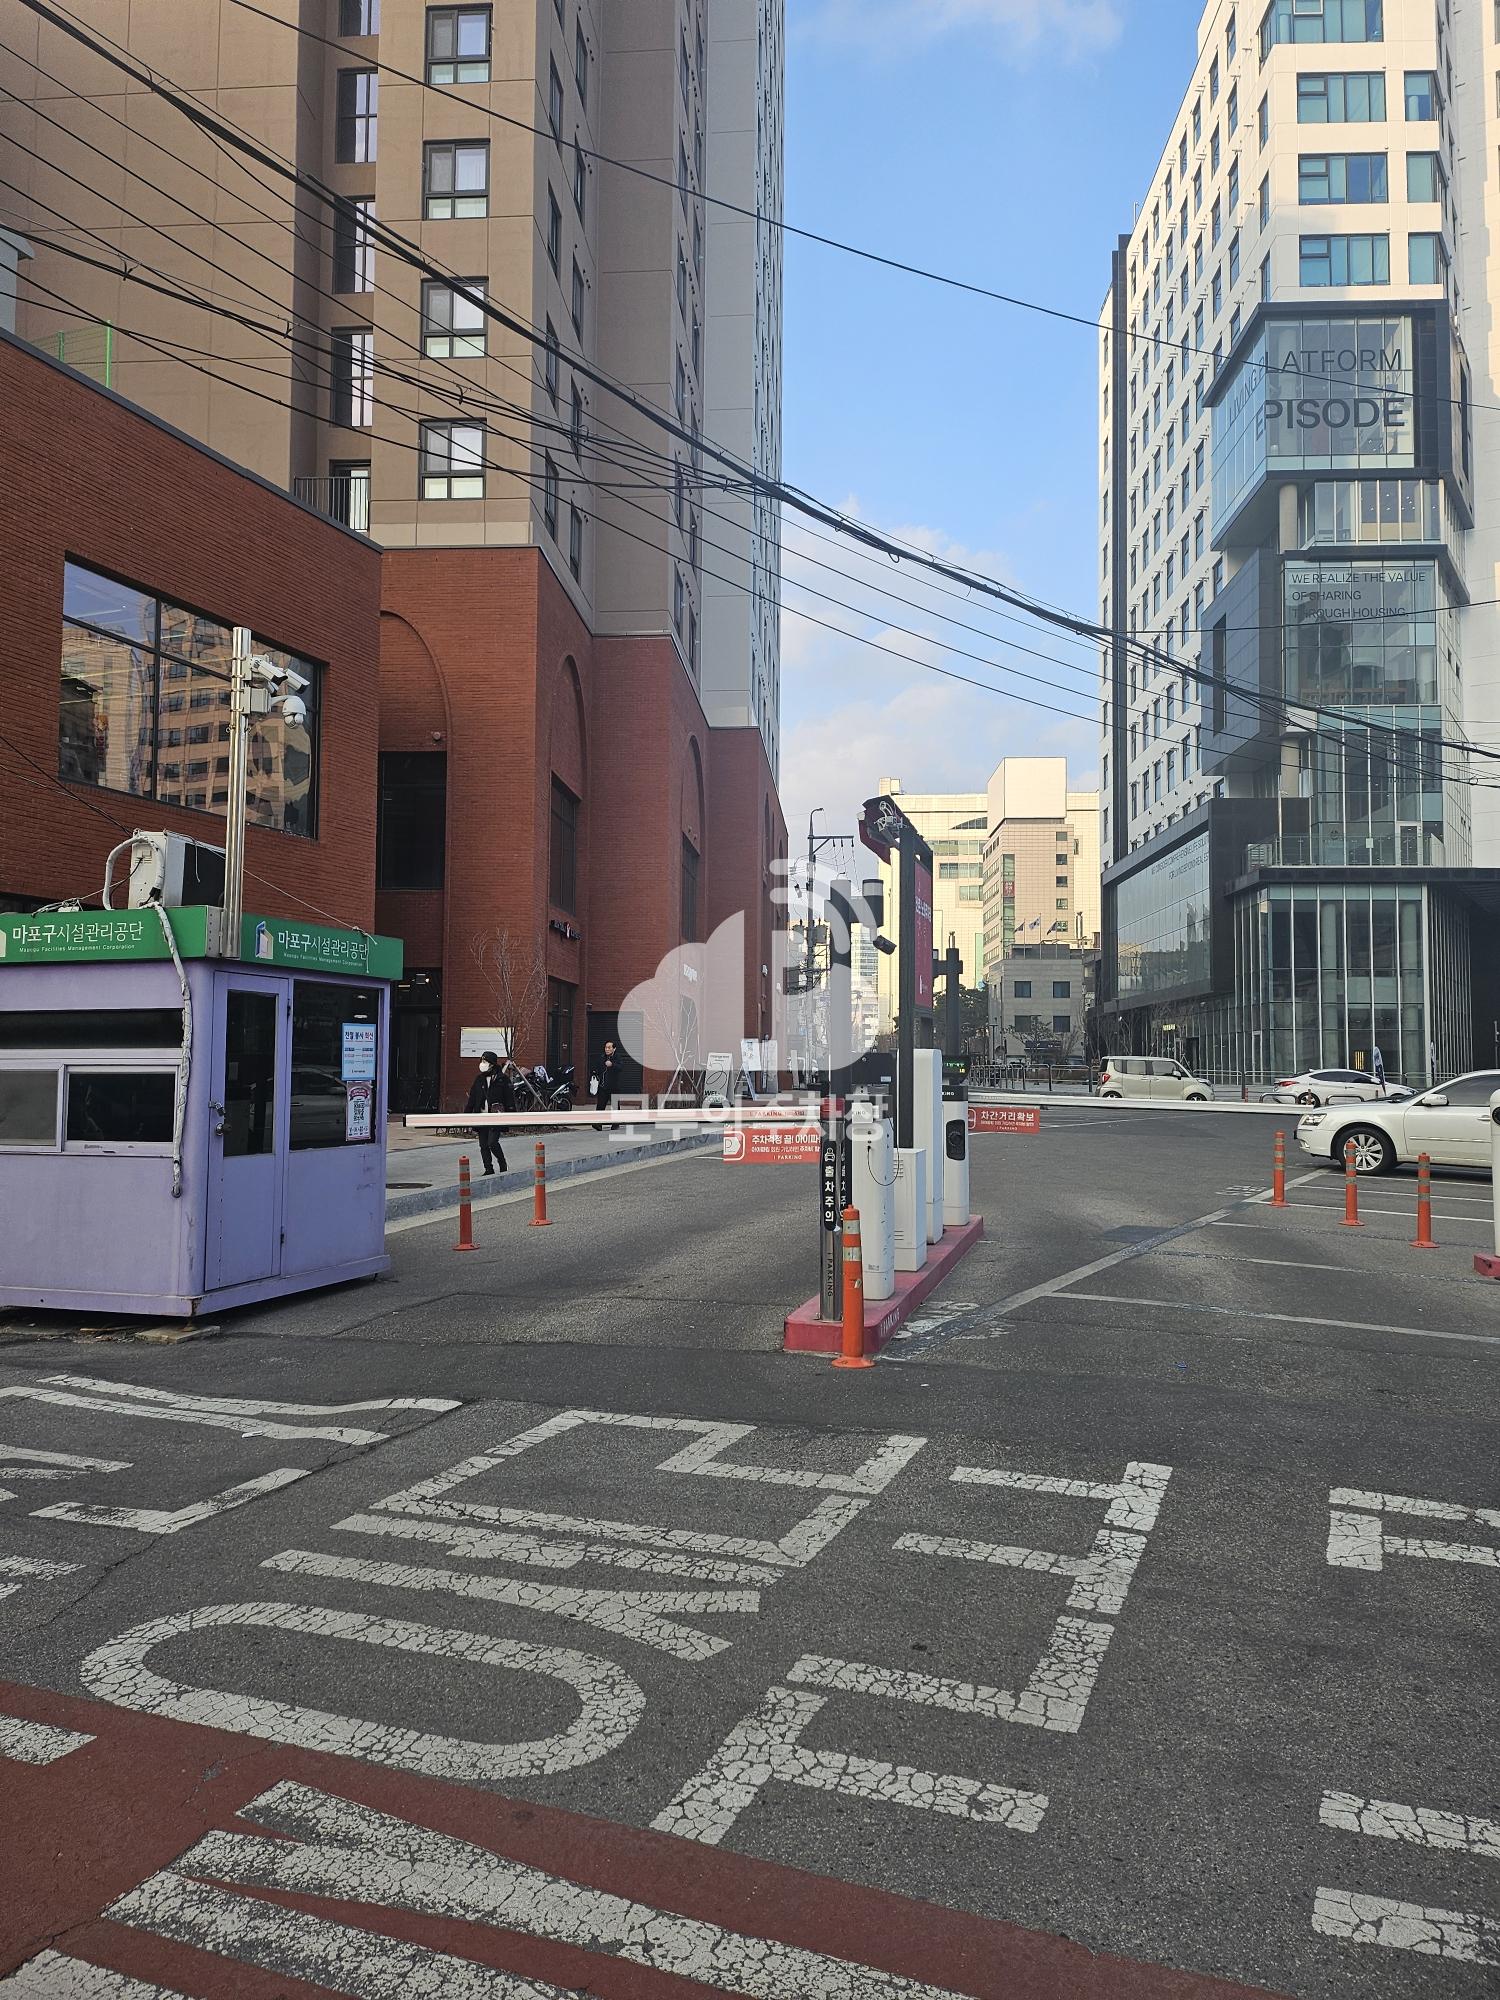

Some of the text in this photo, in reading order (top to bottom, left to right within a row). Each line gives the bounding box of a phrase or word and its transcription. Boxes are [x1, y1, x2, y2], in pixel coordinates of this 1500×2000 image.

[1255, 398, 1405, 441] EPISODE
[1291, 571, 1426, 583] WE REALIZE THE VALUE
[1291, 590, 1361, 601] OF SHARING
[1292, 608, 1350, 618] THROUGH
[12, 920, 144, 944] 마포구시설관리공단
[278, 930, 368, 960] 마포구시설관리공단
[752, 1134, 782, 1145] 주차걱정
[824, 1165, 835, 1222] 출차주의
